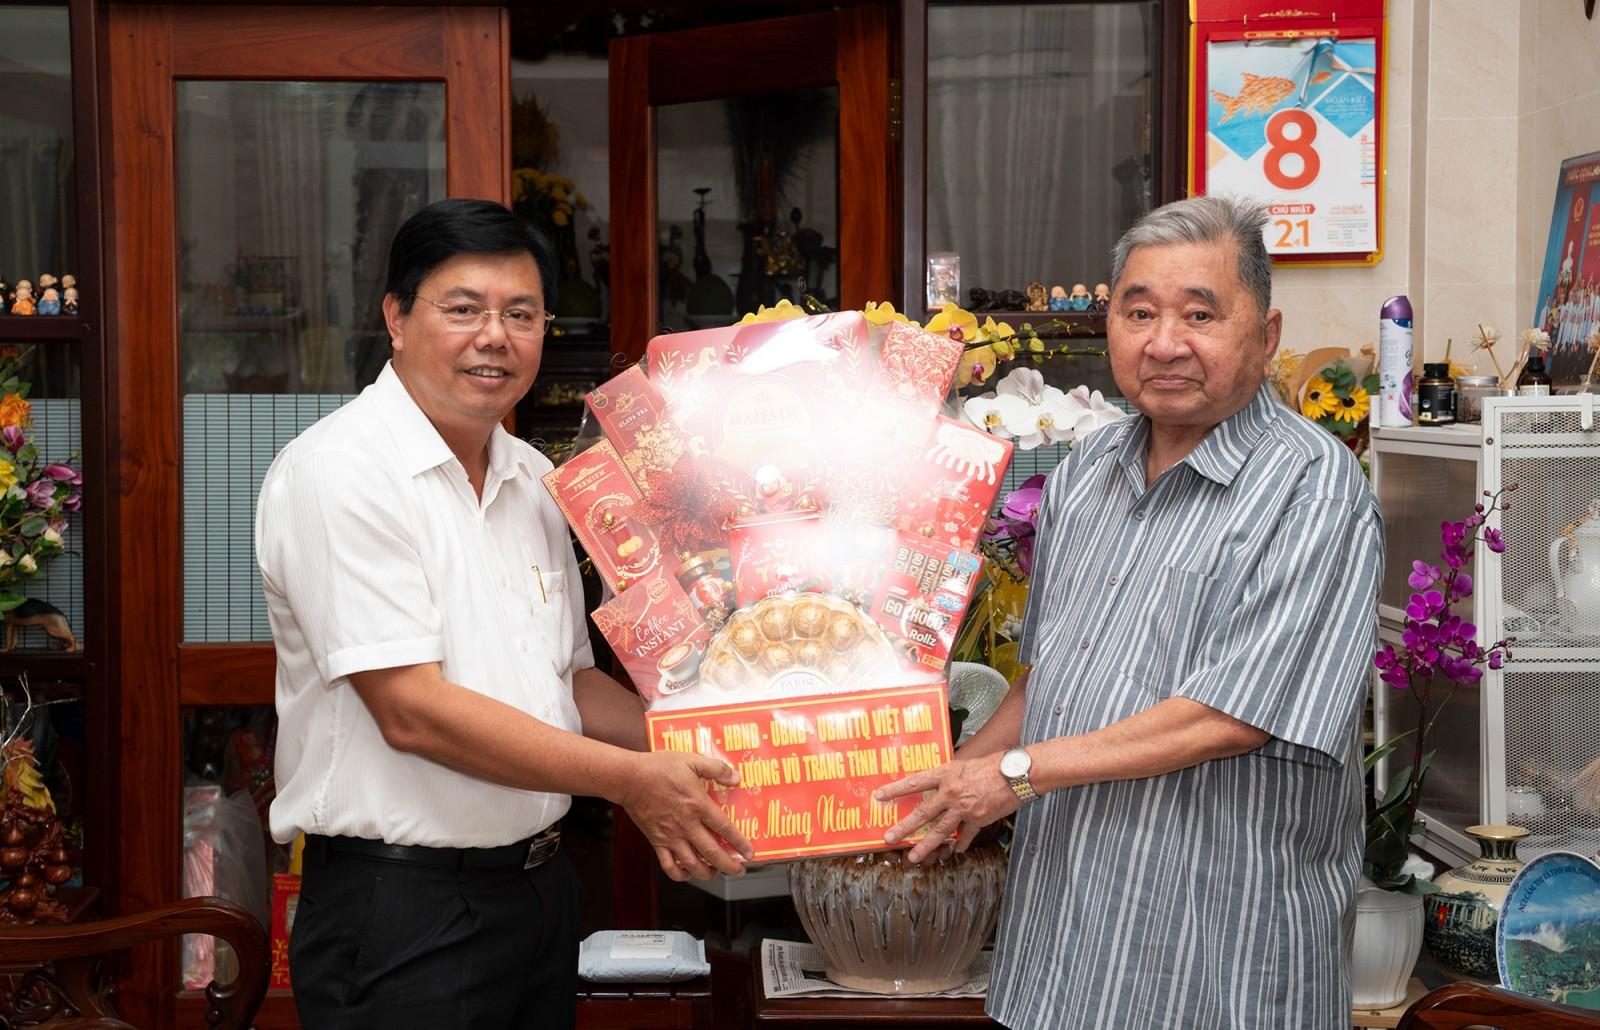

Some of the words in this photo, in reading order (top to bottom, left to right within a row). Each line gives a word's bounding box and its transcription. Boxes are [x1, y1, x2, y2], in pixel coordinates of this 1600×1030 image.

[1263, 109, 1321, 190] 8
[1273, 218, 1310, 248] 21
[635, 613, 670, 642] Coffee
[635, 619, 687, 658] INSTANT
[909, 629, 938, 646] Rollz
[769, 715, 807, 748] UBND
[871, 704, 900, 740] VIỆT
[902, 702, 933, 734] NAM
[802, 751, 846, 782] TRANG
[846, 744, 879, 778] TỈNH
[881, 746, 899, 774] AN
[901, 742, 942, 773] GIANG
[764, 799, 814, 844] Mừng
[817, 793, 863, 833] Năm
